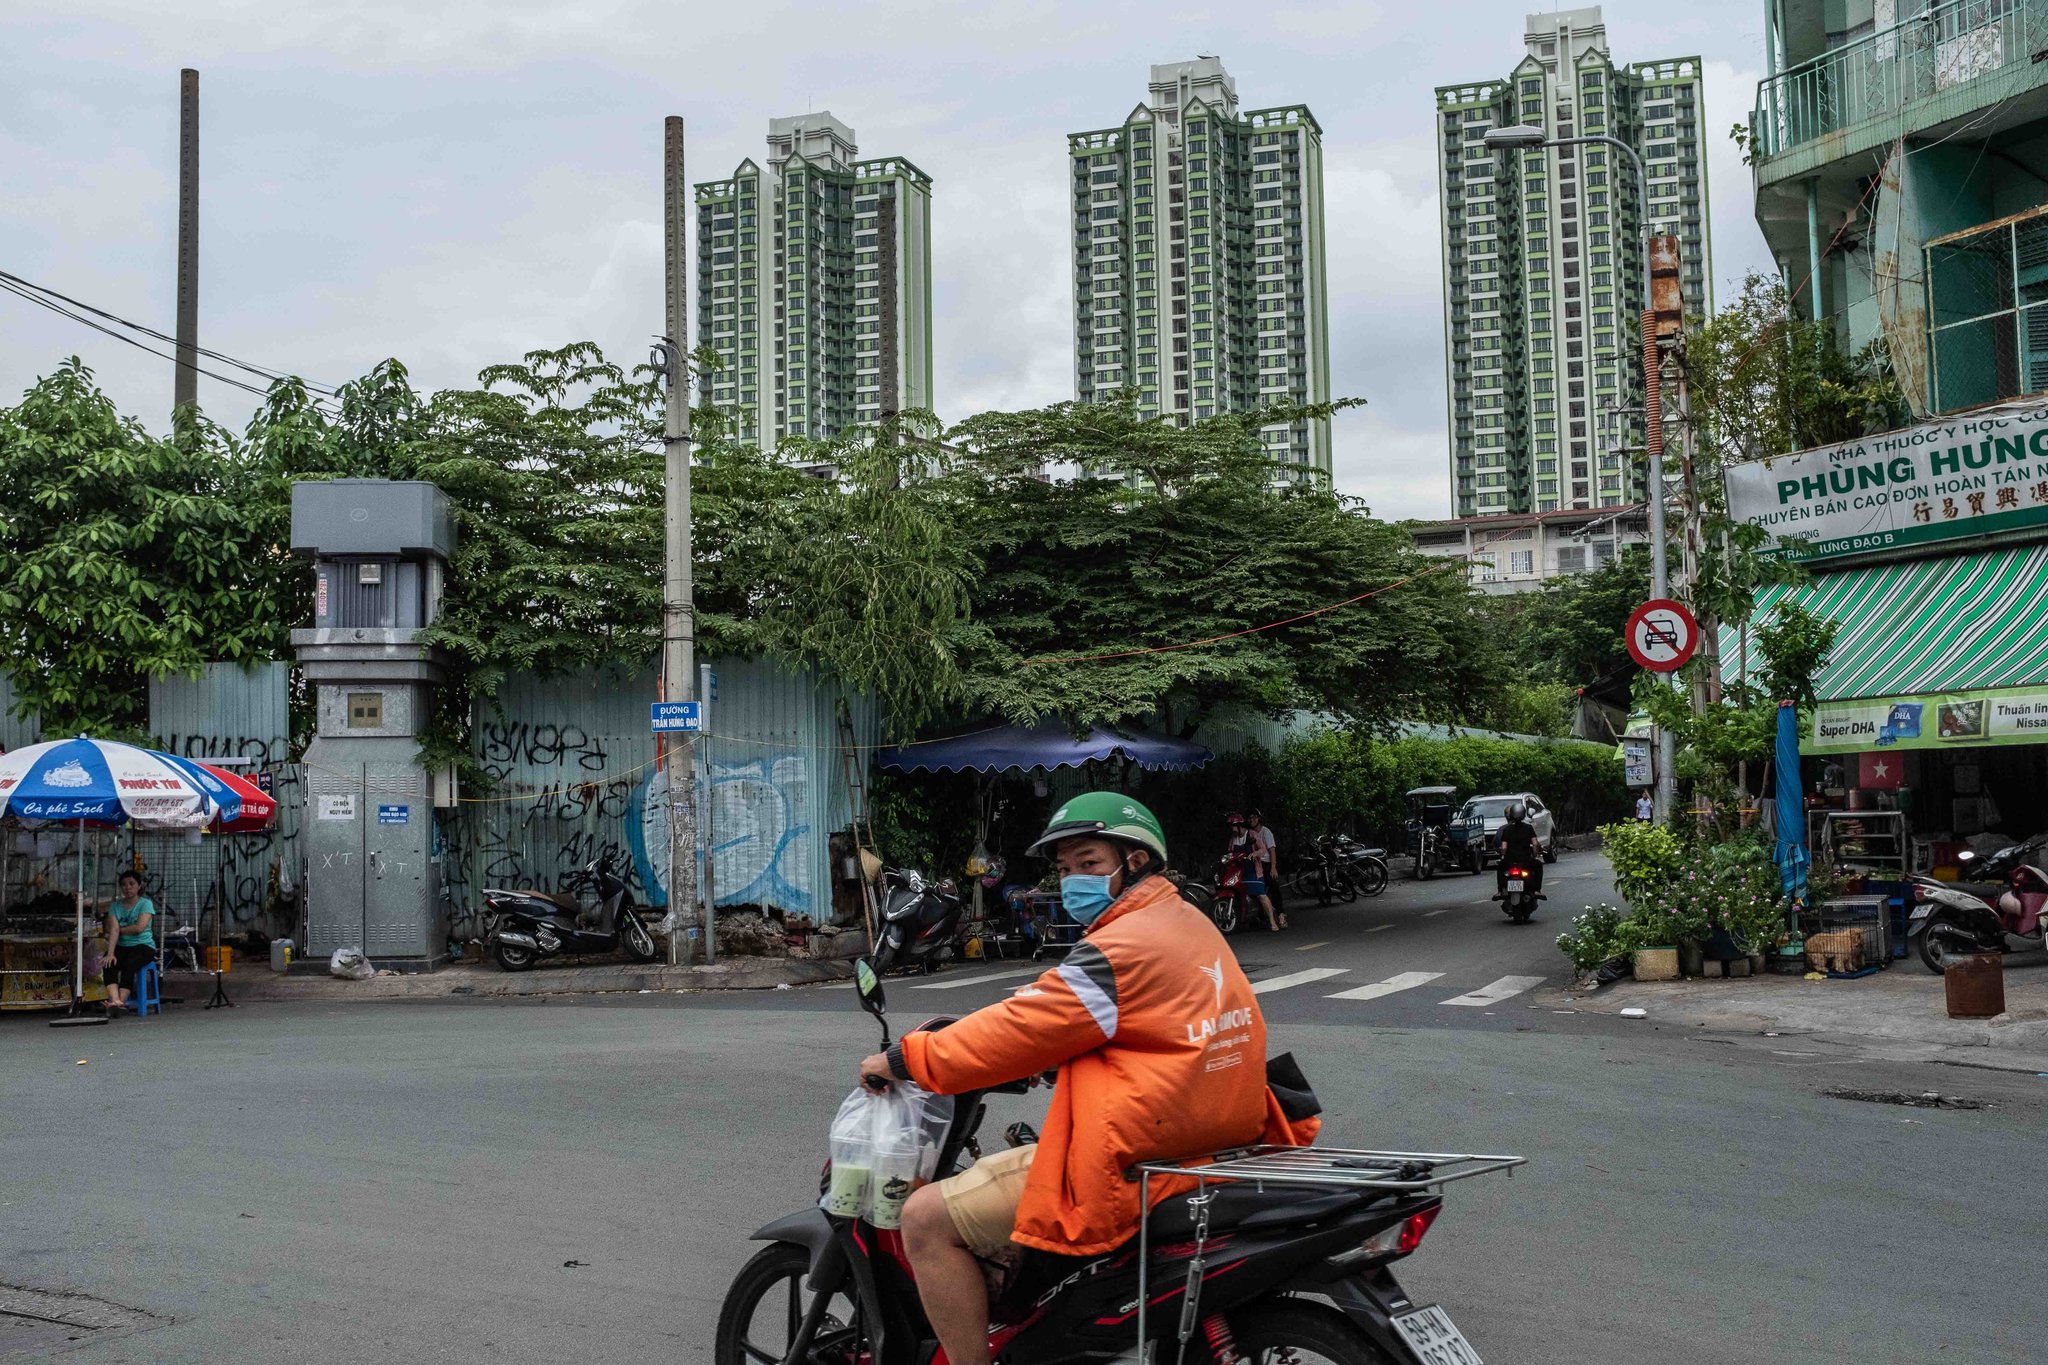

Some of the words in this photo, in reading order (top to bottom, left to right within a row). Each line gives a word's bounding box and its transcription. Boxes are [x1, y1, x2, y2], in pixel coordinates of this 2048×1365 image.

[1829, 443, 1868, 463] NHÀ
[1873, 427, 1941, 453] THUỐC
[1945, 426, 1956, 439] Y
[1777, 457, 1916, 505] PHÙNG
[1748, 506, 1810, 527] CHUYÊN
[1815, 499, 1848, 517] BÁN
[1853, 492, 1888, 510] CAO
[1893, 484, 1929, 502] ĐƠN
[1935, 474, 1986, 496] HOÀN
[1991, 466, 2031, 485] TÁN
[1853, 535, 1882, 549] ĐẠO
[1884, 533, 1895, 544] B
[660, 705, 690, 715] ĐƯỜNG
[1894, 712, 1911, 720] DHA
[1820, 724, 1850, 739] Super
[1851, 720, 1875, 735] DHA
[23, 802, 43, 815] Cà
[45, 802, 68, 815] phê
[72, 802, 104, 816] Sạch
[1402, 1310, 1451, 1345] 59-HA
